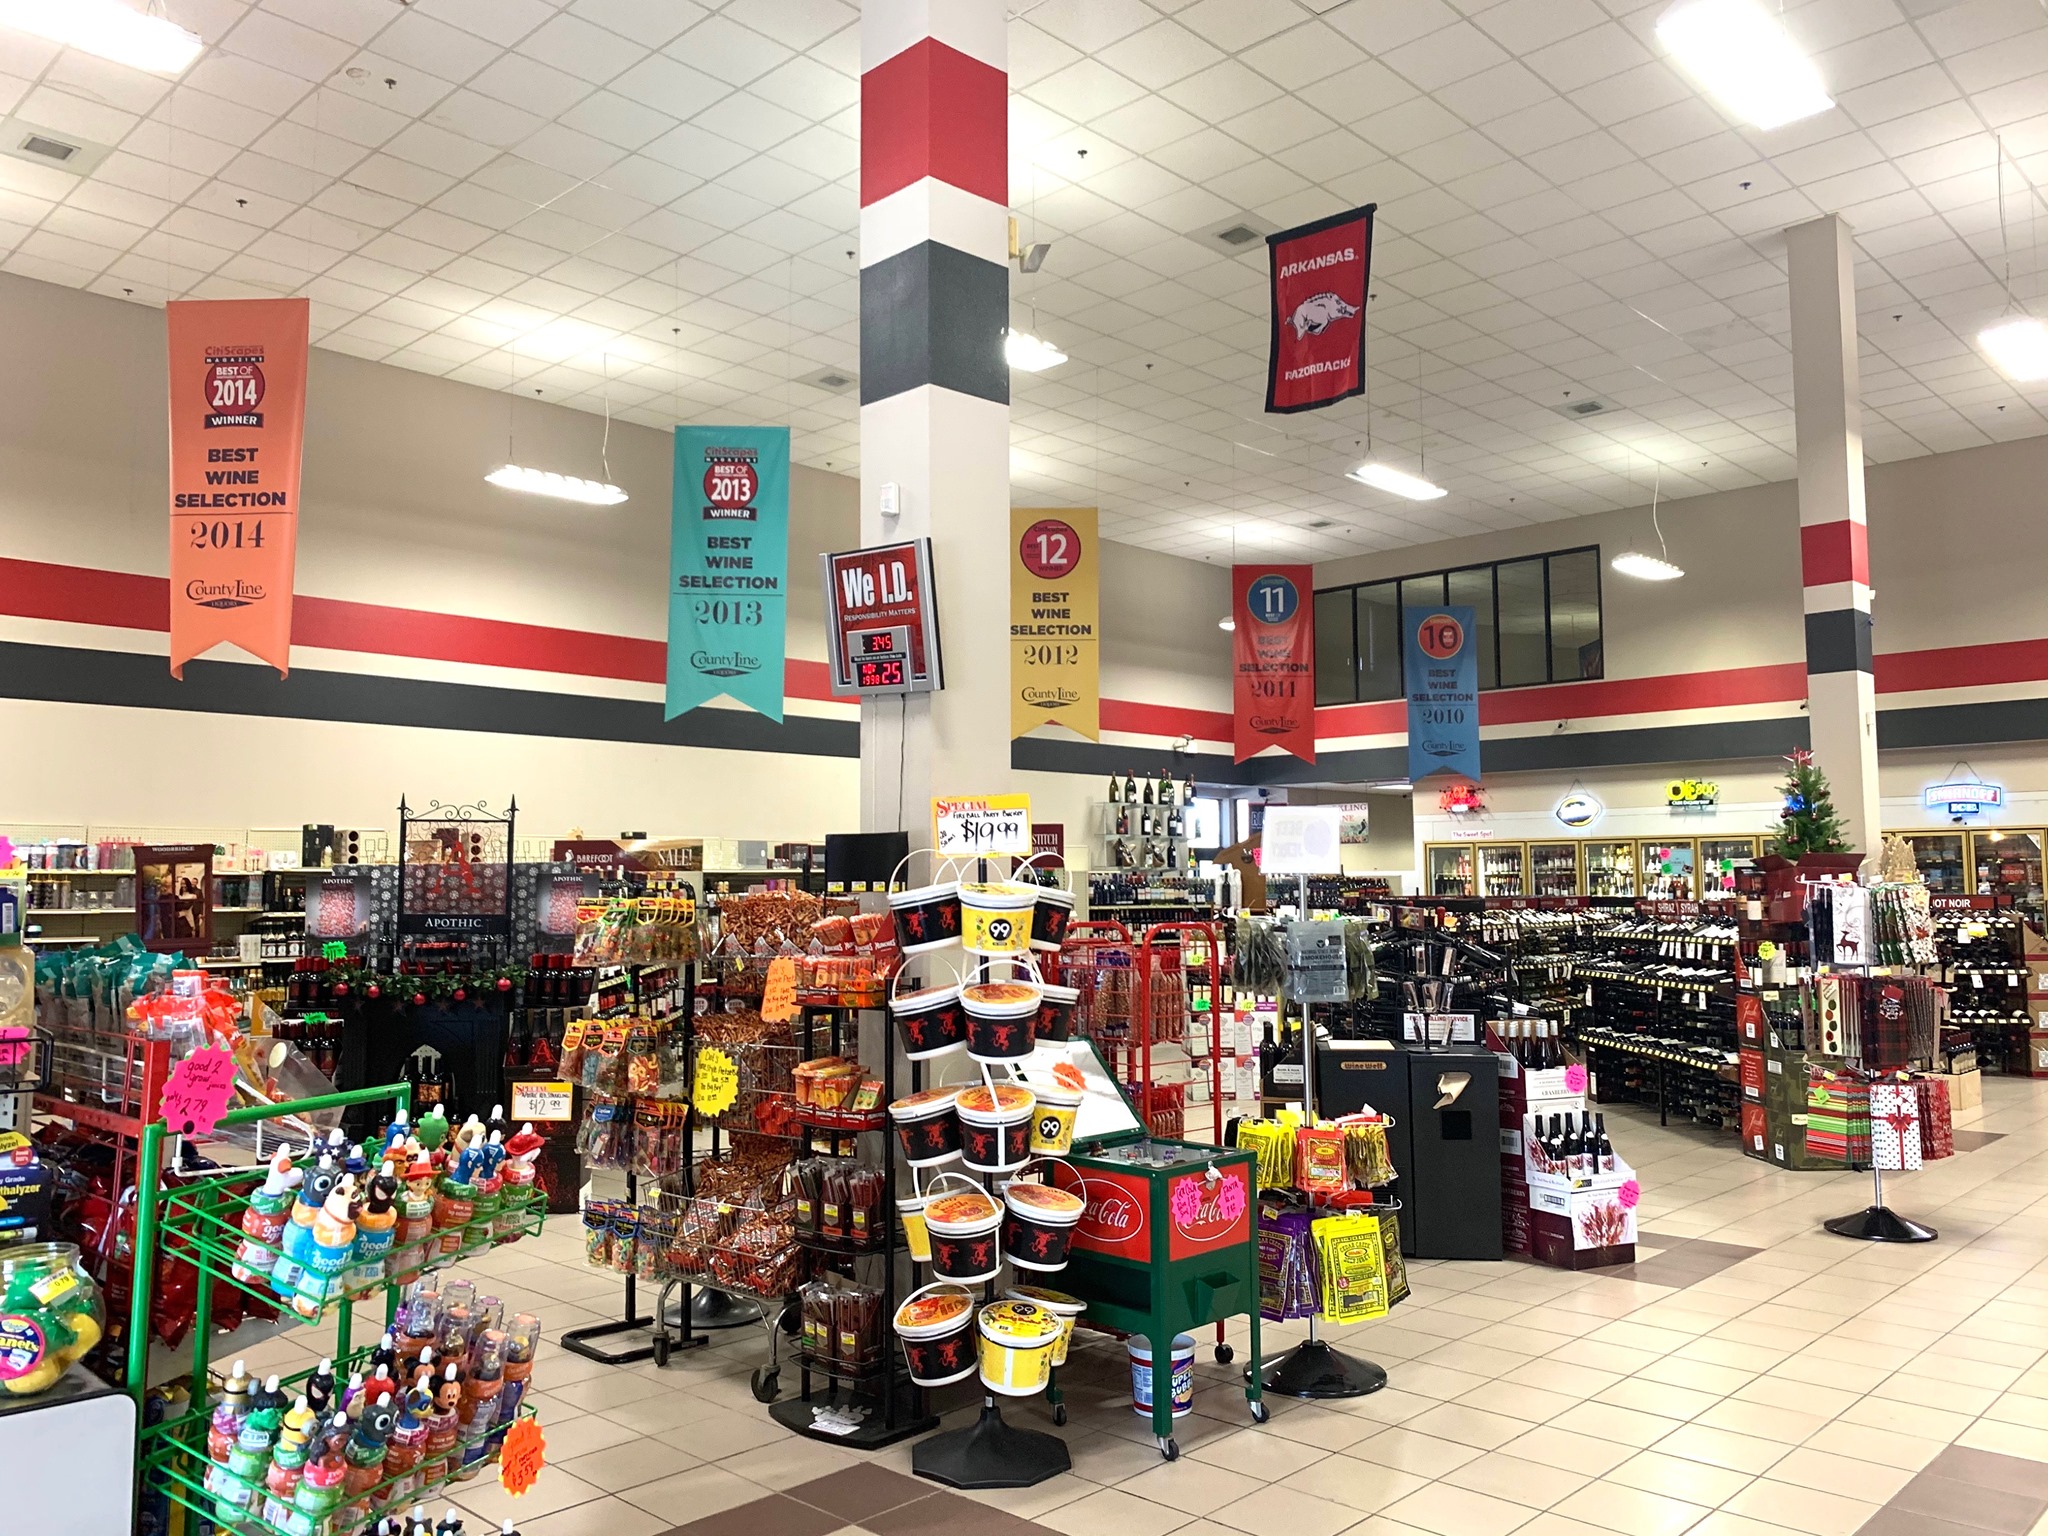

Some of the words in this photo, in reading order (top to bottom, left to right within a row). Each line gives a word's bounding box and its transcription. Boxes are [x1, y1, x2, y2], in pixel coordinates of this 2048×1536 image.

[1280, 248, 1355, 279] ARKANSAS
[205, 345, 264, 356] CitiScapes
[216, 366, 238, 376] BEST
[239, 366, 253, 375] OF
[212, 380, 257, 406] 2014
[211, 414, 257, 427] WINNER
[207, 448, 258, 463] BEST
[704, 446, 758, 457] CitiScapes
[714, 465, 735, 474] BEST
[735, 465, 748, 474] OF
[205, 470, 259, 485] WINE
[711, 478, 751, 500] 2013
[174, 491, 286, 508] SELECTION
[710, 509, 750, 519] WINNER
[190, 520, 265, 549] 2014
[707, 536, 752, 549] BEST
[1036, 533, 1068, 564] 12
[705, 556, 753, 569] WINE
[679, 575, 778, 589] SELECTION
[842, 567, 875, 608] We
[879, 560, 913, 604] I.D.
[186, 579, 235, 600] County
[234, 579, 266, 598] Line
[1032, 592, 1069, 603] BEST
[1259, 587, 1284, 613] 11
[695, 600, 763, 626] 2013
[844, 610, 889, 622] RESPONSIBILITY
[888, 607, 916, 616] MATTERS
[1031, 609, 1071, 619] WINE
[1010, 624, 1092, 635] SELECTION
[1258, 635, 1288, 645] BEST
[1424, 625, 1458, 649] 10
[691, 650, 736, 669] County
[734, 651, 762, 669] Line
[1023, 645, 1078, 665] 2012
[1257, 649, 1290, 659] WINE
[882, 663, 900, 683] 25
[1239, 663, 1309, 673] SELECTION
[1428, 669, 1456, 677] BEST
[1251, 681, 1296, 698] 2011
[1428, 681, 1457, 690] WINE
[1021, 686, 1058, 701] County
[1057, 686, 1080, 701] Line
[1412, 693, 1473, 702] SELECTION
[1423, 708, 1464, 724] 2010
[1929, 787, 1997, 802] SMIRNOFF
[937, 801, 988, 818] SPECIAL
[953, 811, 980, 819] FIREBALL
[577, 853, 613, 863] BAREFOOT
[658, 849, 693, 867] SALE!
[1658, 902, 1675, 913] SHIRAZ
[1681, 902, 1699, 913] SYRAH
[1949, 899, 1971, 908] NOIR
[425, 918, 482, 928] APOTHIC
[990, 922, 1011, 938] 99
[184, 1058, 212, 1078] good
[212, 1060, 222, 1074] 2
[187, 1074, 210, 1088] grow
[515, 1085, 547, 1095] SPECIAL
[1041, 1119, 1060, 1135] 99
[0, 1184, 41, 1196] thalyzer
[1223, 1181, 1239, 1196] FANTA
[1339, 1242, 1355, 1253] CEDAR
[312, 1249, 347, 1268] good
[1014, 1304, 1035, 1315] 99
[1171, 1370, 1193, 1387] UPER
